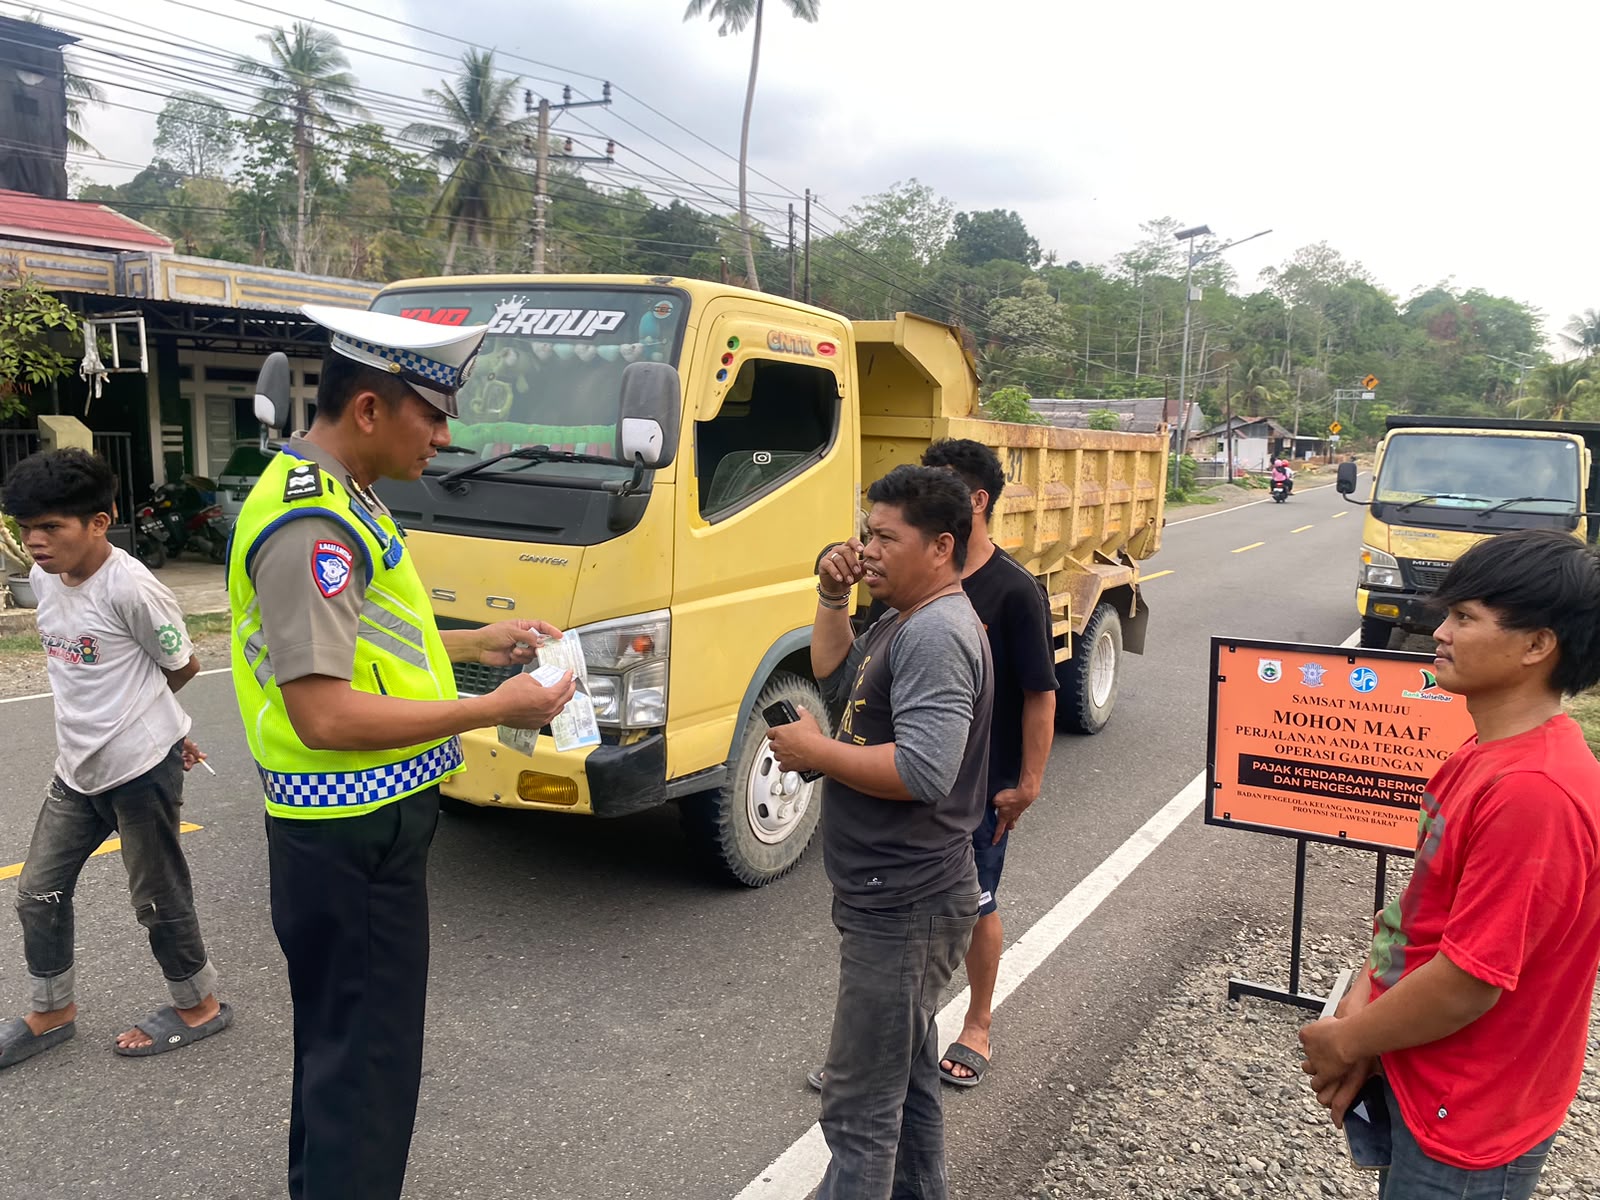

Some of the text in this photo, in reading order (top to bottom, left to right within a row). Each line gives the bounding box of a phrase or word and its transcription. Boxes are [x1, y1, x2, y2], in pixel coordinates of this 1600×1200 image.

[488, 308, 625, 337] GROUP
[519, 552, 568, 567] CANTER
[1292, 694, 1411, 716] SAMSAT MAMUJU
[1235, 725, 1327, 746] PERJALANAN
[1329, 737, 1370, 751] ANDA
[1273, 709, 1431, 742] MOHON MAAF
[1274, 743, 1424, 773] OPERASI GABUNGAN
[1252, 761, 1292, 775] PAJAK
[1294, 767, 1374, 787] KENDARAAN
[1273, 774, 1300, 787] DAN
[1303, 779, 1390, 800] PENGESAHAN
[1236, 790, 1420, 824] BADAN PENGELOLA KEUANGAN DAN PENDAPATA
[1292, 805, 1398, 828] PROVINSI SULAWESI BARAT
